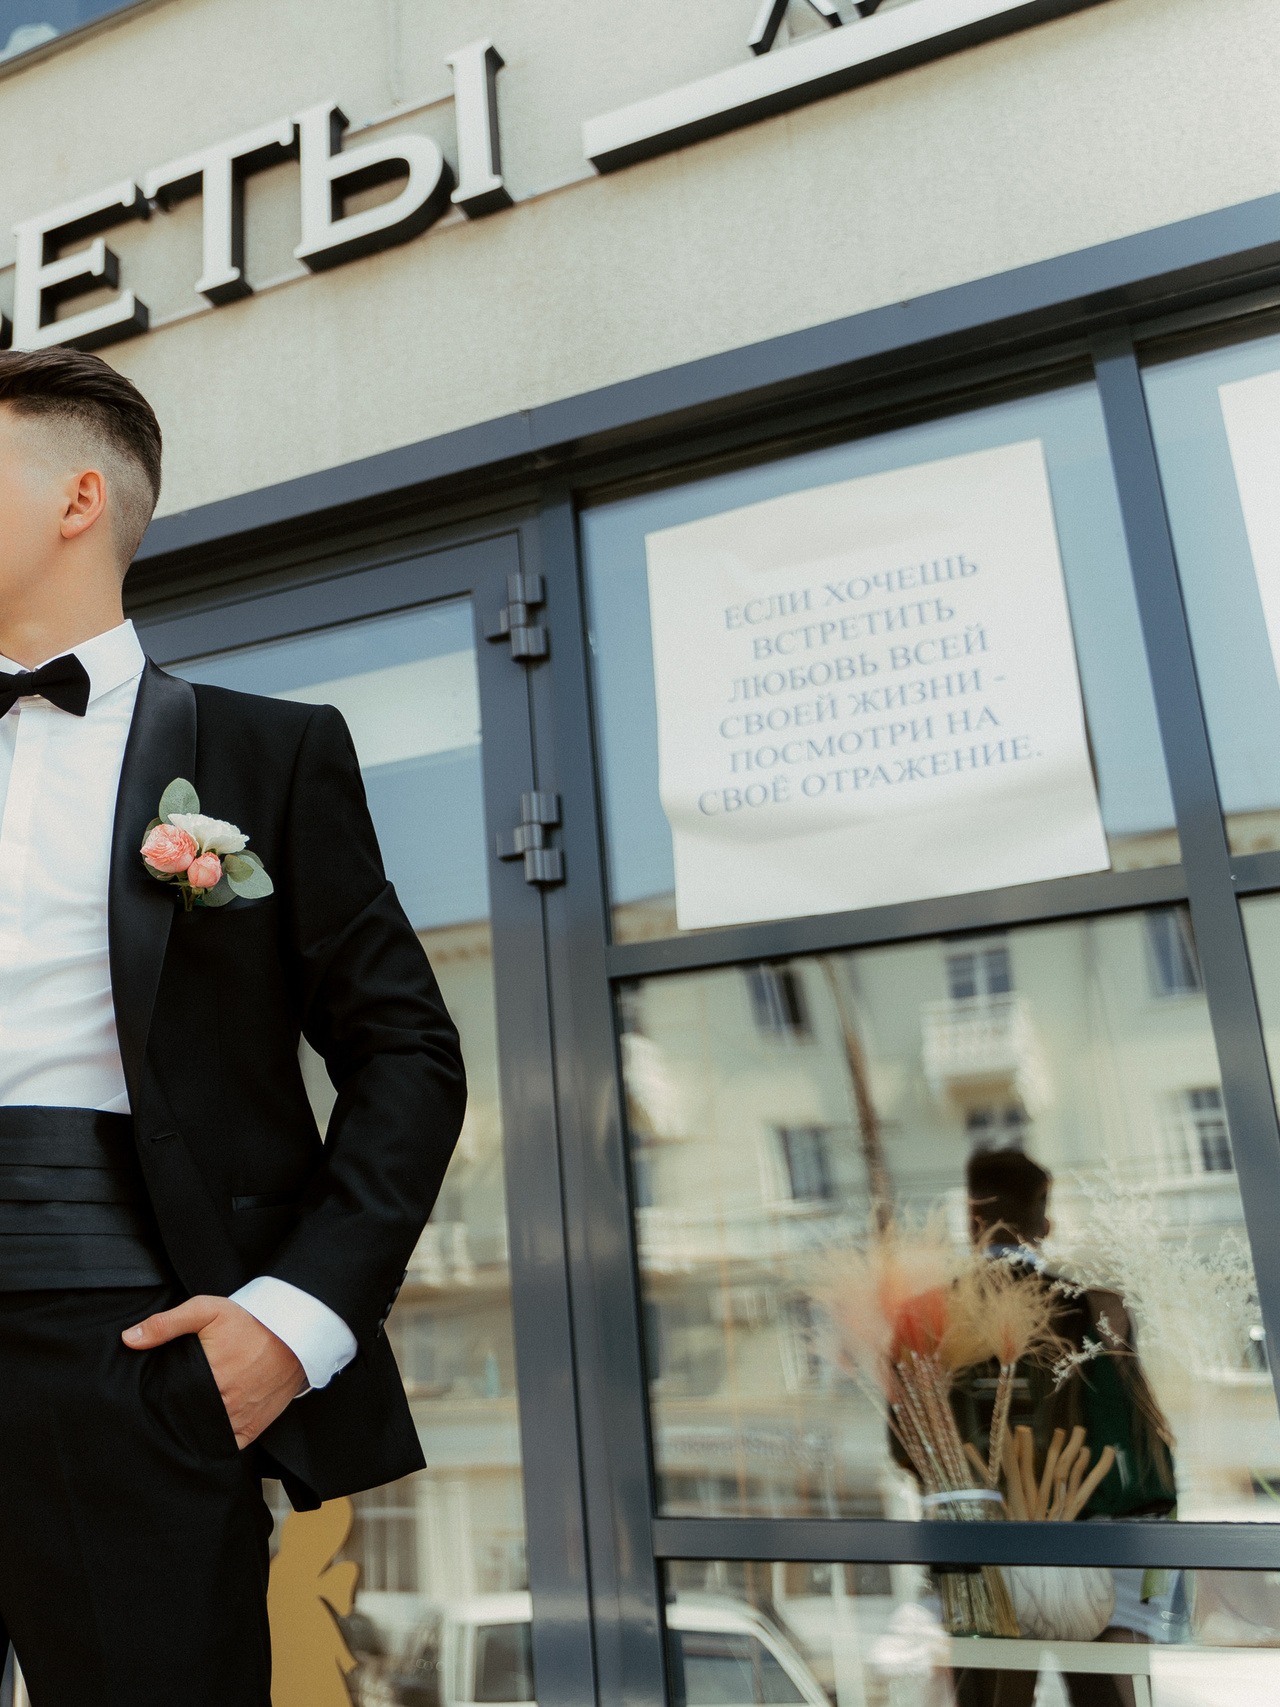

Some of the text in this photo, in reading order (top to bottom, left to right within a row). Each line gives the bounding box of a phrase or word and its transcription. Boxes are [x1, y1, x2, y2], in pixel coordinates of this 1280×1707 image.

[723, 554, 979, 631] ЕСЛИ ХОЧЕШЬ
[751, 598, 956, 661] ВСТРЕТИТЬ
[726, 621, 990, 705] ЛЮБОВЬ ВСЕЙ
[718, 689, 839, 740] СВОЕЙ
[851, 668, 984, 716] ЖИЗНИ
[728, 705, 1001, 774] ПОСМОТРИ НА
[697, 735, 1043, 818] СВОЁ ОТРАЖЕНИЕ.
